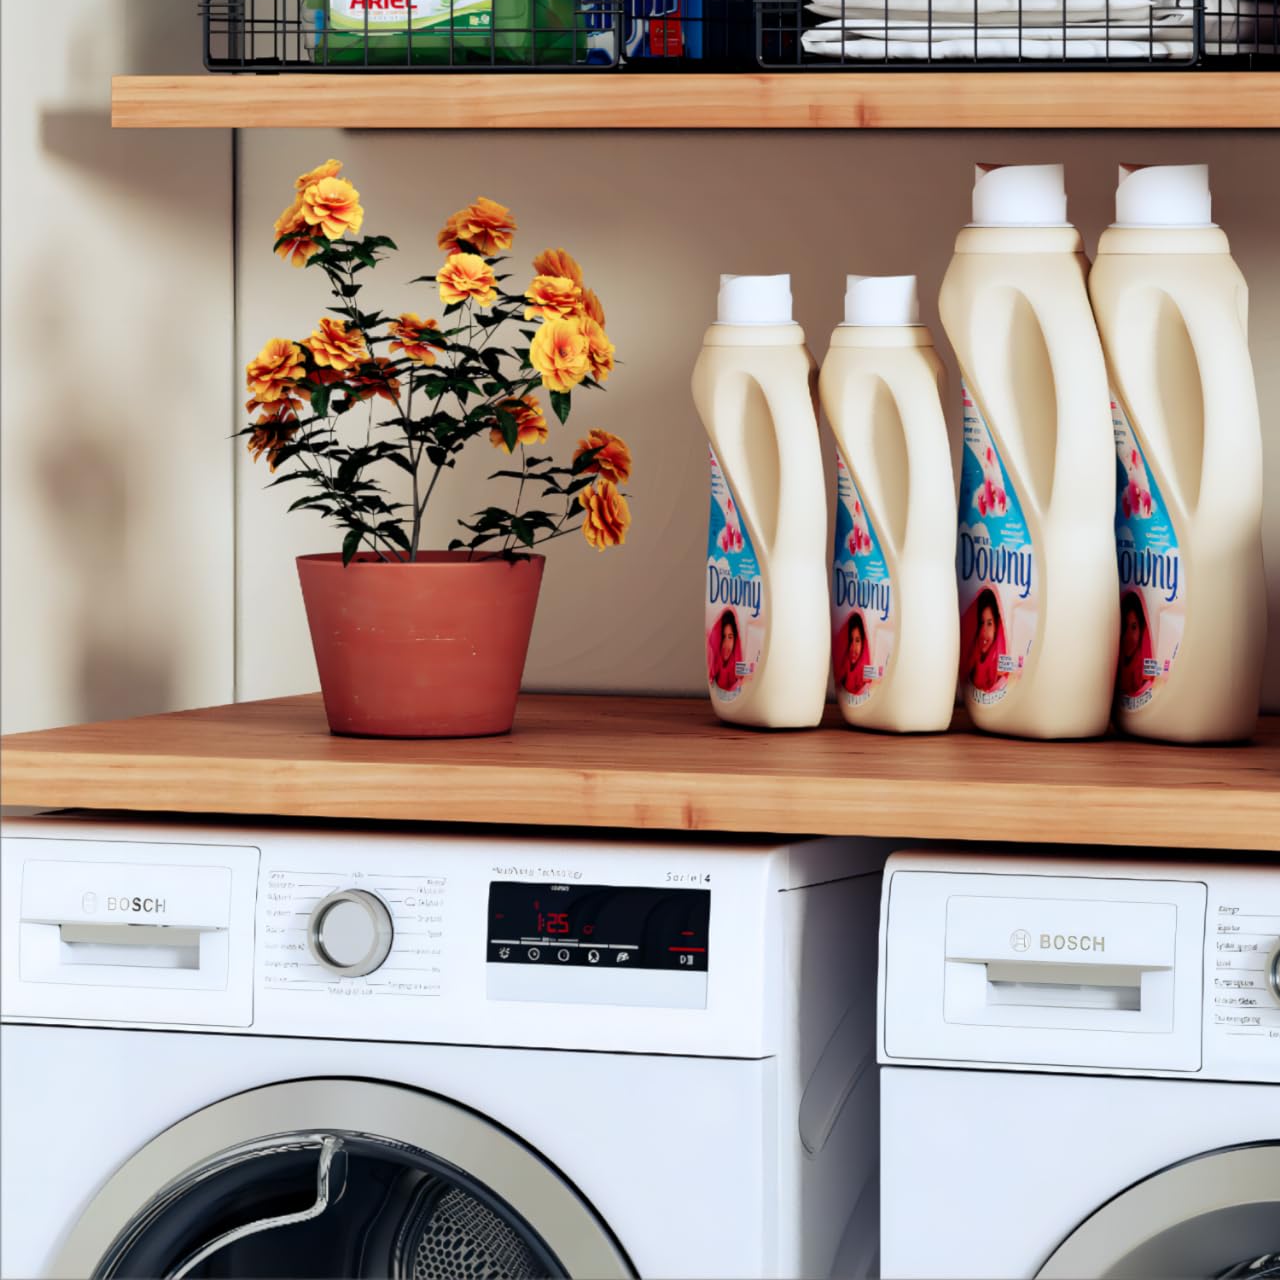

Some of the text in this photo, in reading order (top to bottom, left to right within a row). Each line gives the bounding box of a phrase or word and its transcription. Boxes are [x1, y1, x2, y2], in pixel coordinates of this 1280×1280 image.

[709, 565, 761, 617] Downy
[961, 532, 1032, 598] Downy
[1119, 547, 1179, 602] owny
[836, 567, 890, 621] Downy
[107, 896, 166, 913] BOSCH
[536, 912, 569, 934] 1:25
[1039, 933, 1105, 952] BOSCH
